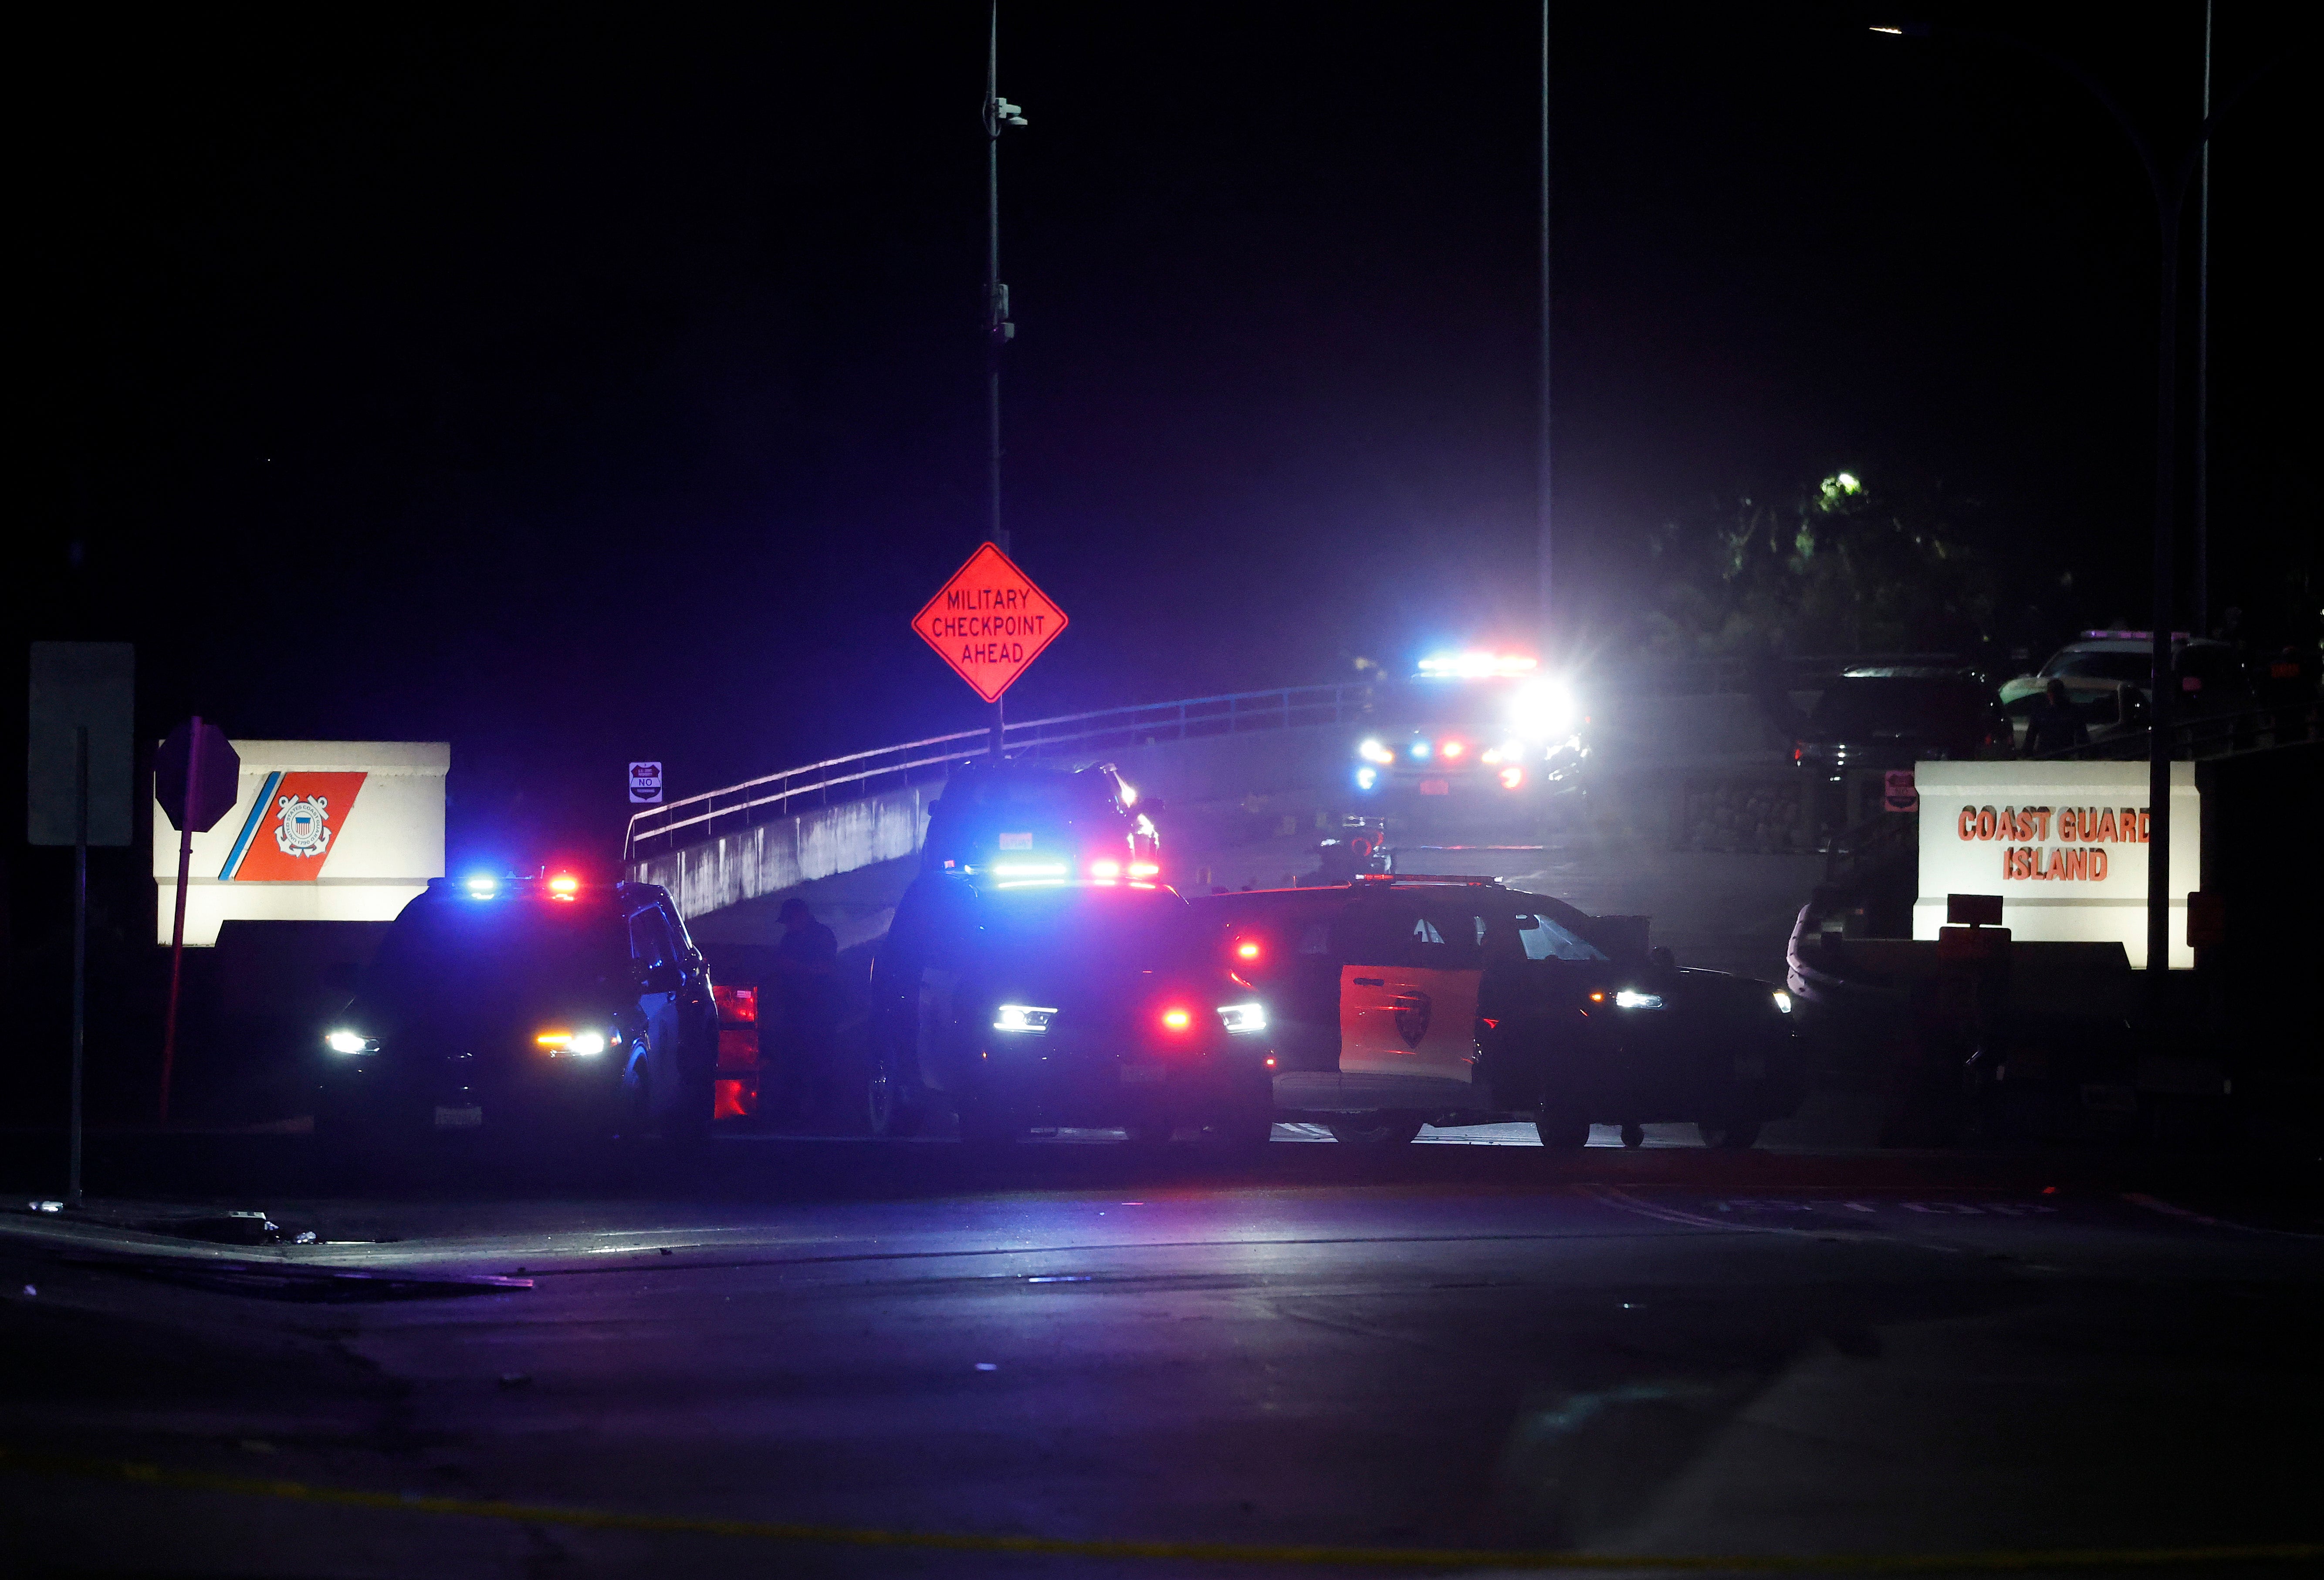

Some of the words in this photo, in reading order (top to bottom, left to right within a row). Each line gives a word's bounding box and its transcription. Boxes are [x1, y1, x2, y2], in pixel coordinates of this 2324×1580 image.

[947, 589, 1030, 610] MILITARY
[932, 616, 1045, 637] CHECKPOINT
[962, 643, 1023, 663] AHEAD
[287, 805, 302, 821] STATES
[303, 805, 319, 819] COAST
[286, 822, 297, 842] UNITED
[311, 820, 320, 841] GUARD
[1958, 809, 2051, 842] COAST
[2059, 810, 2150, 842] GUARD
[2003, 849, 2107, 881] ISLAND
